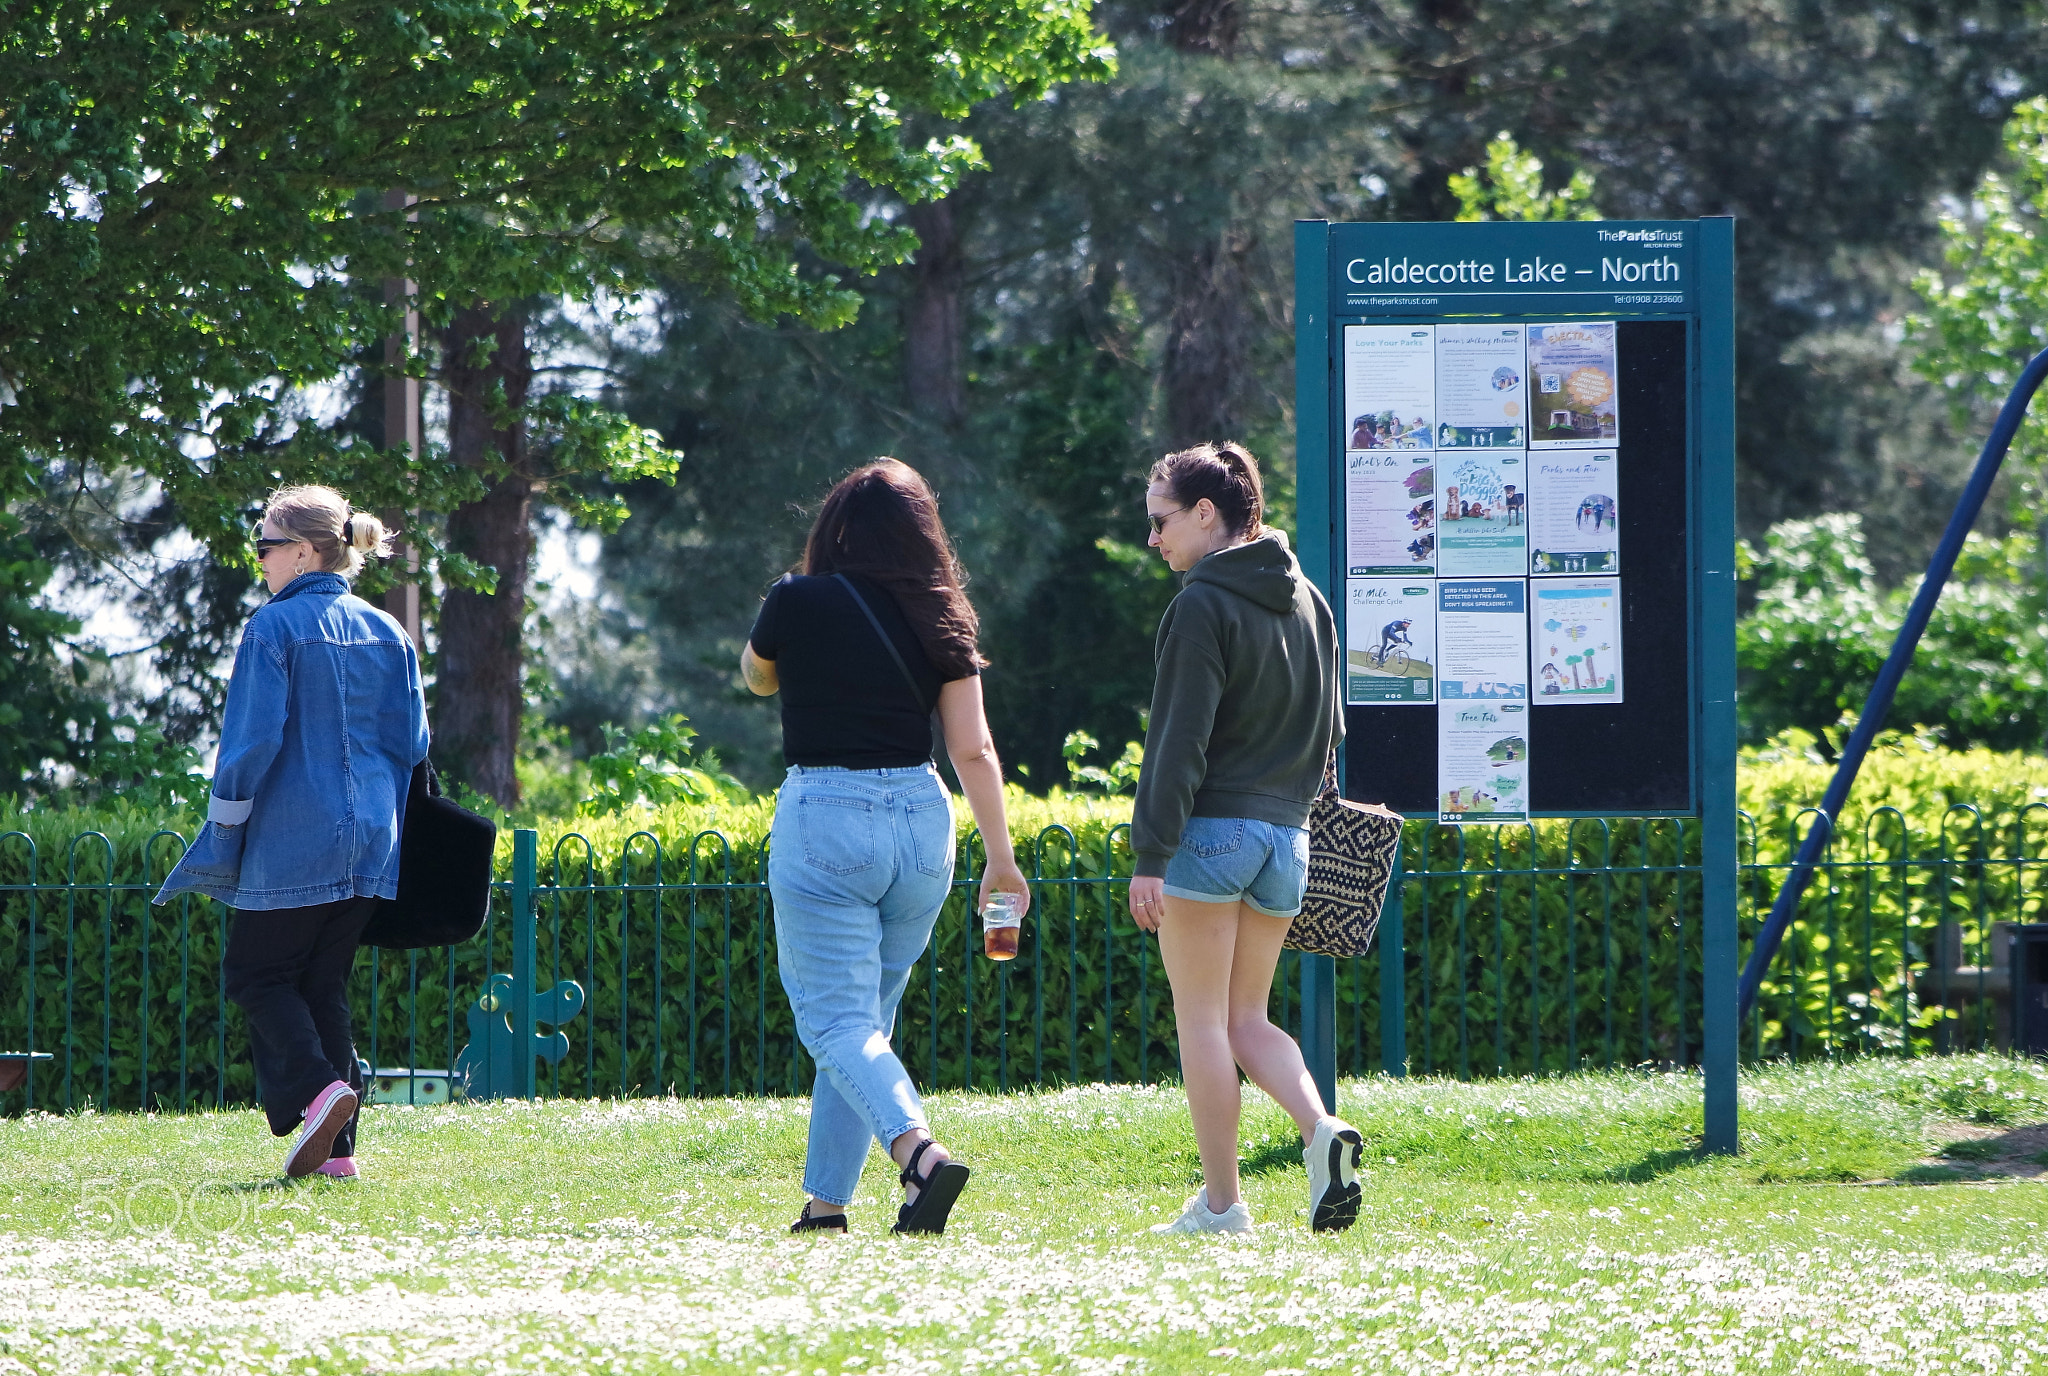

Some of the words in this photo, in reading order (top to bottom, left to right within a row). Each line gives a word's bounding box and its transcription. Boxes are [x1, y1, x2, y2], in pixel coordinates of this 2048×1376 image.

[1597, 229, 1683, 242] TheParksTrust
[1346, 256, 1495, 284] Caldecotte
[1505, 256, 1567, 283] Lake
[1602, 255, 1681, 282] North
[1347, 297, 1438, 306] www.theparkstrust.com
[1613, 295, 1651, 304] Tel:01908
[1653, 295, 1683, 304] 233600
[1350, 456, 1381, 468] What's
[1384, 456, 1399, 467] On
[1366, 588, 1388, 598] Mile
[1461, 712, 1478, 722] Tree
